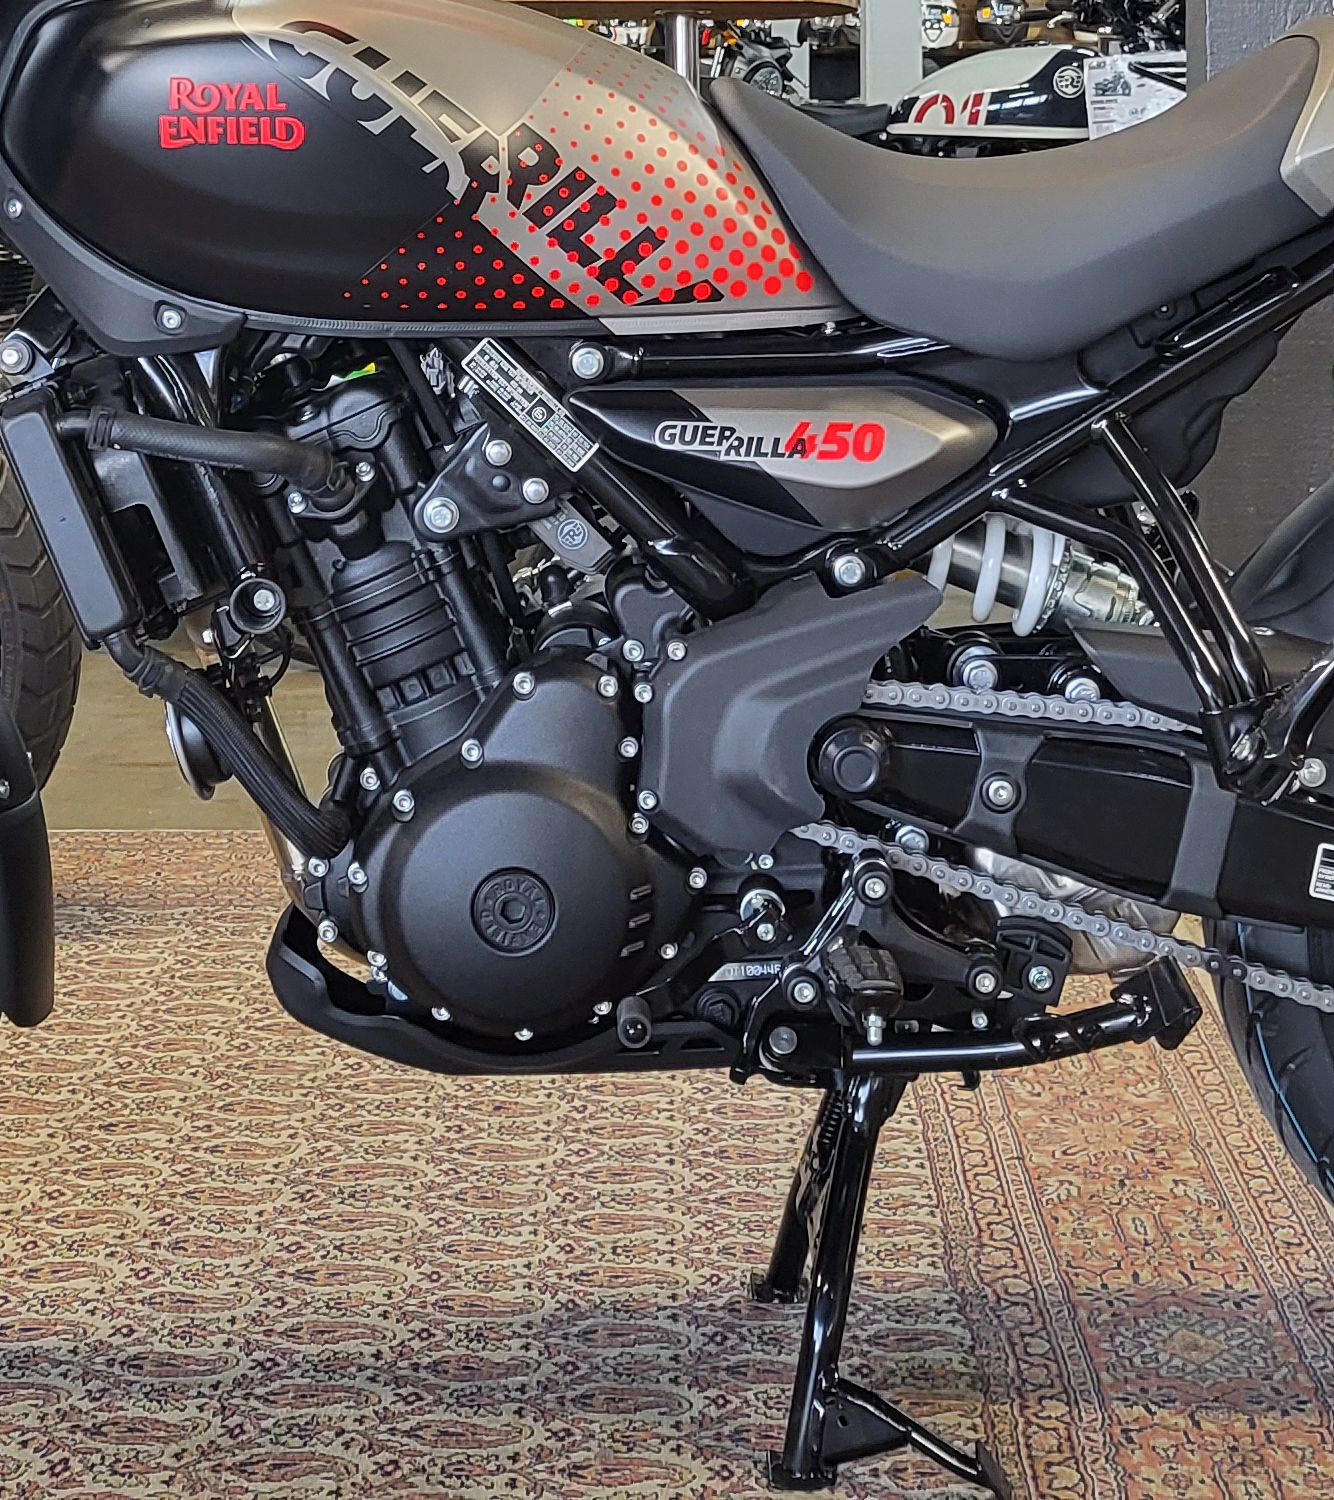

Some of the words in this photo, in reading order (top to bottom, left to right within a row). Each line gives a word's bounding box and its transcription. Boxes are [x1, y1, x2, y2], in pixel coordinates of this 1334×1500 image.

[168, 76, 288, 113] ROYAL
[158, 113, 305, 151] ENFIELD
[783, 421, 886, 463] 450
